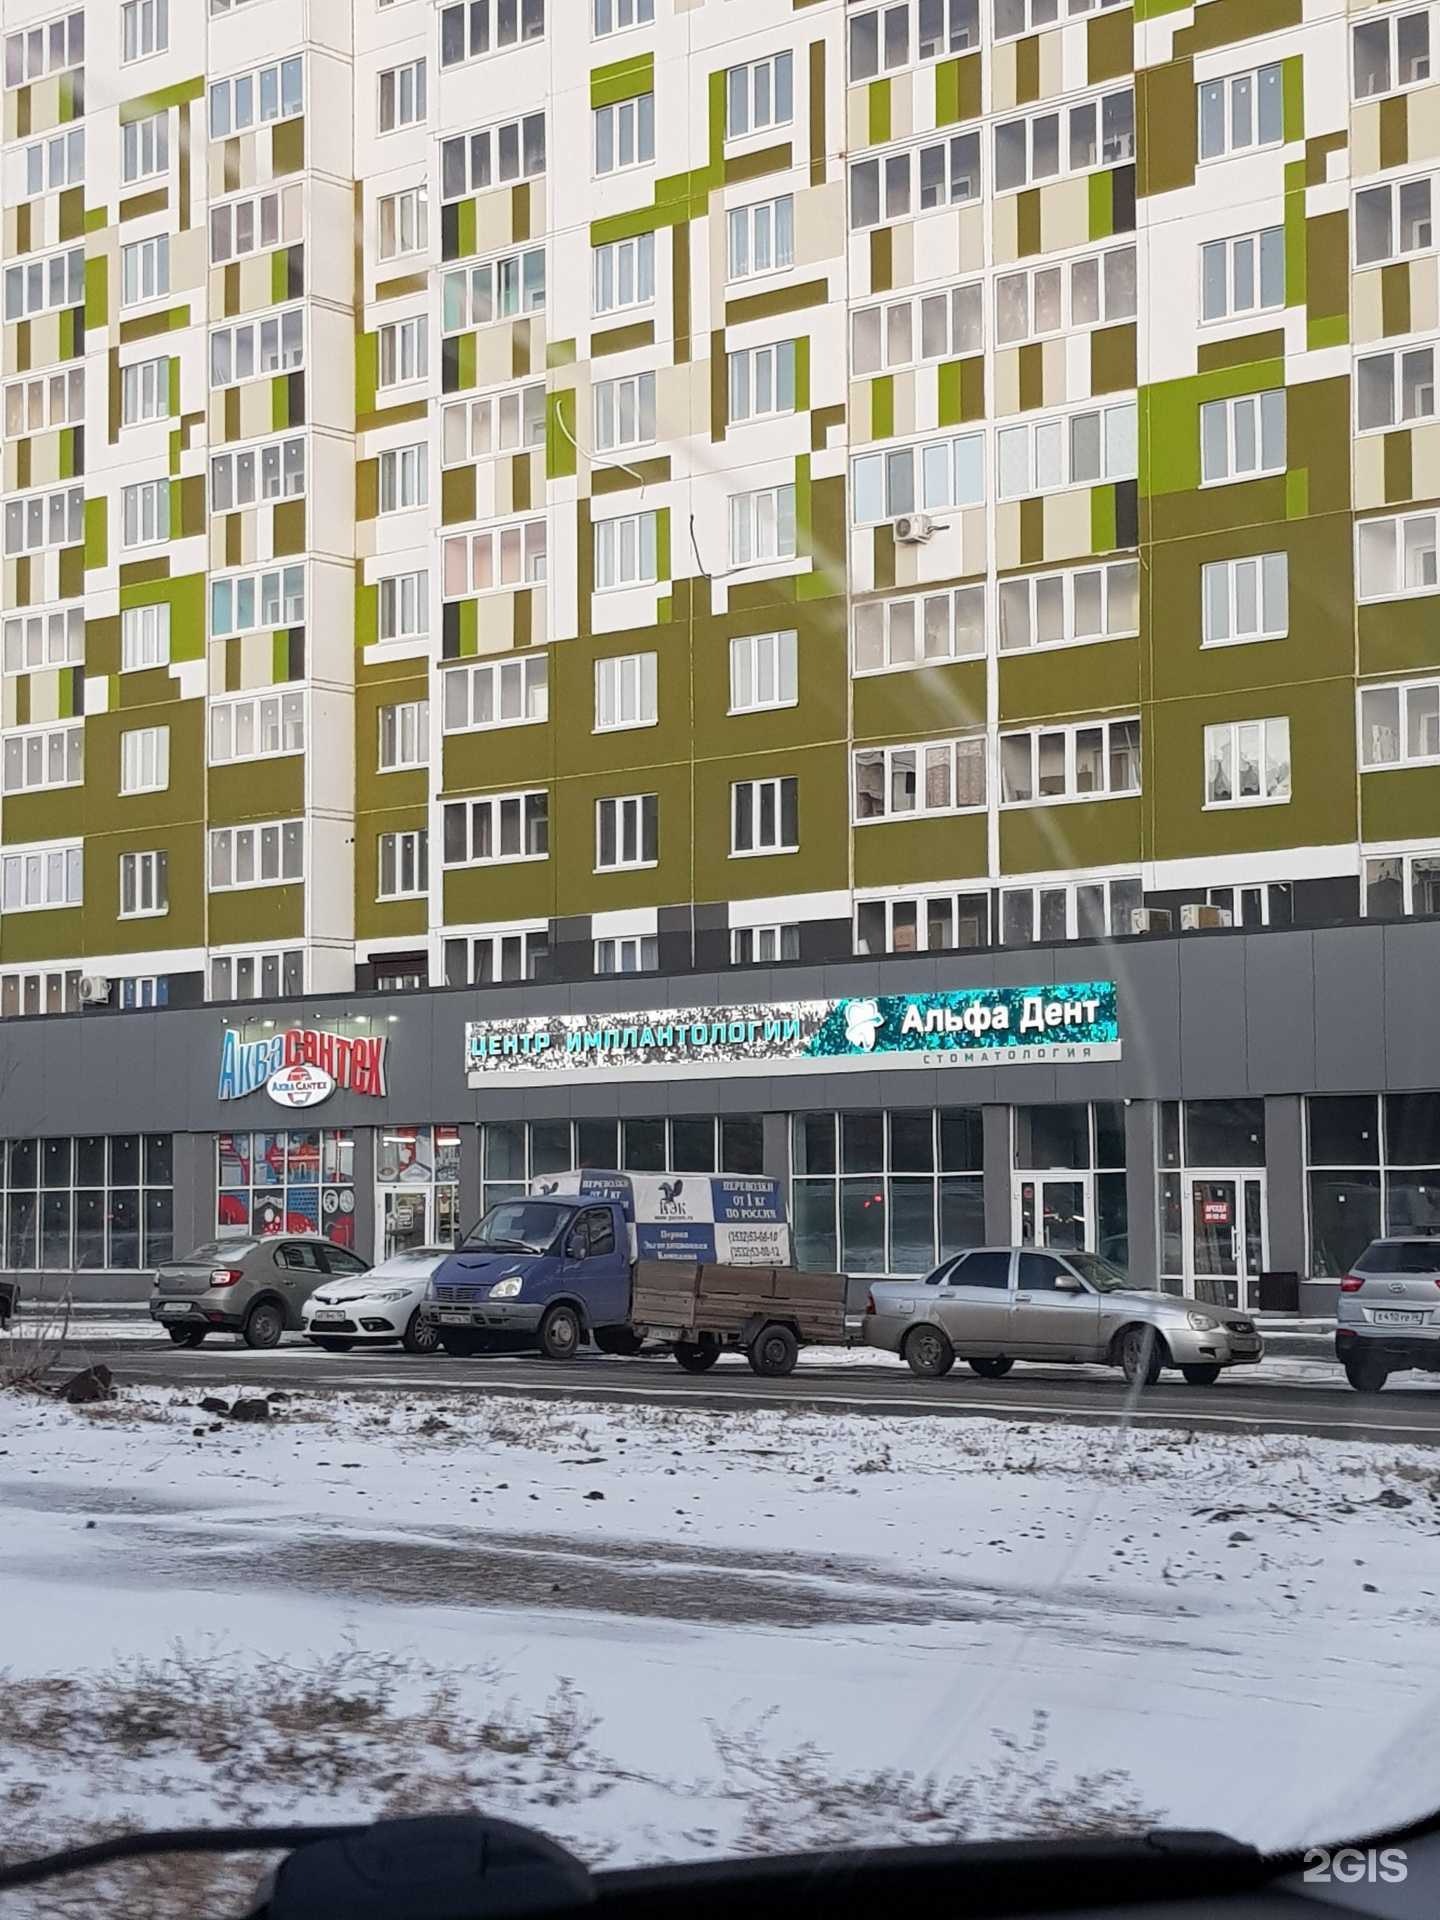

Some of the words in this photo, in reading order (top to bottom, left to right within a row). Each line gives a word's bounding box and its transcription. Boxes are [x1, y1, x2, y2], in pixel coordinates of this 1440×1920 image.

[902, 1003, 1009, 1037] Альфа
[1019, 996, 1100, 1033] Дент
[470, 1034, 551, 1056] ЦЕНТР
[566, 1018, 801, 1051] ИМПЛАНТОЛОГИИ
[922, 1047, 1093, 1065] СТОМАТОЛОГИЯ
